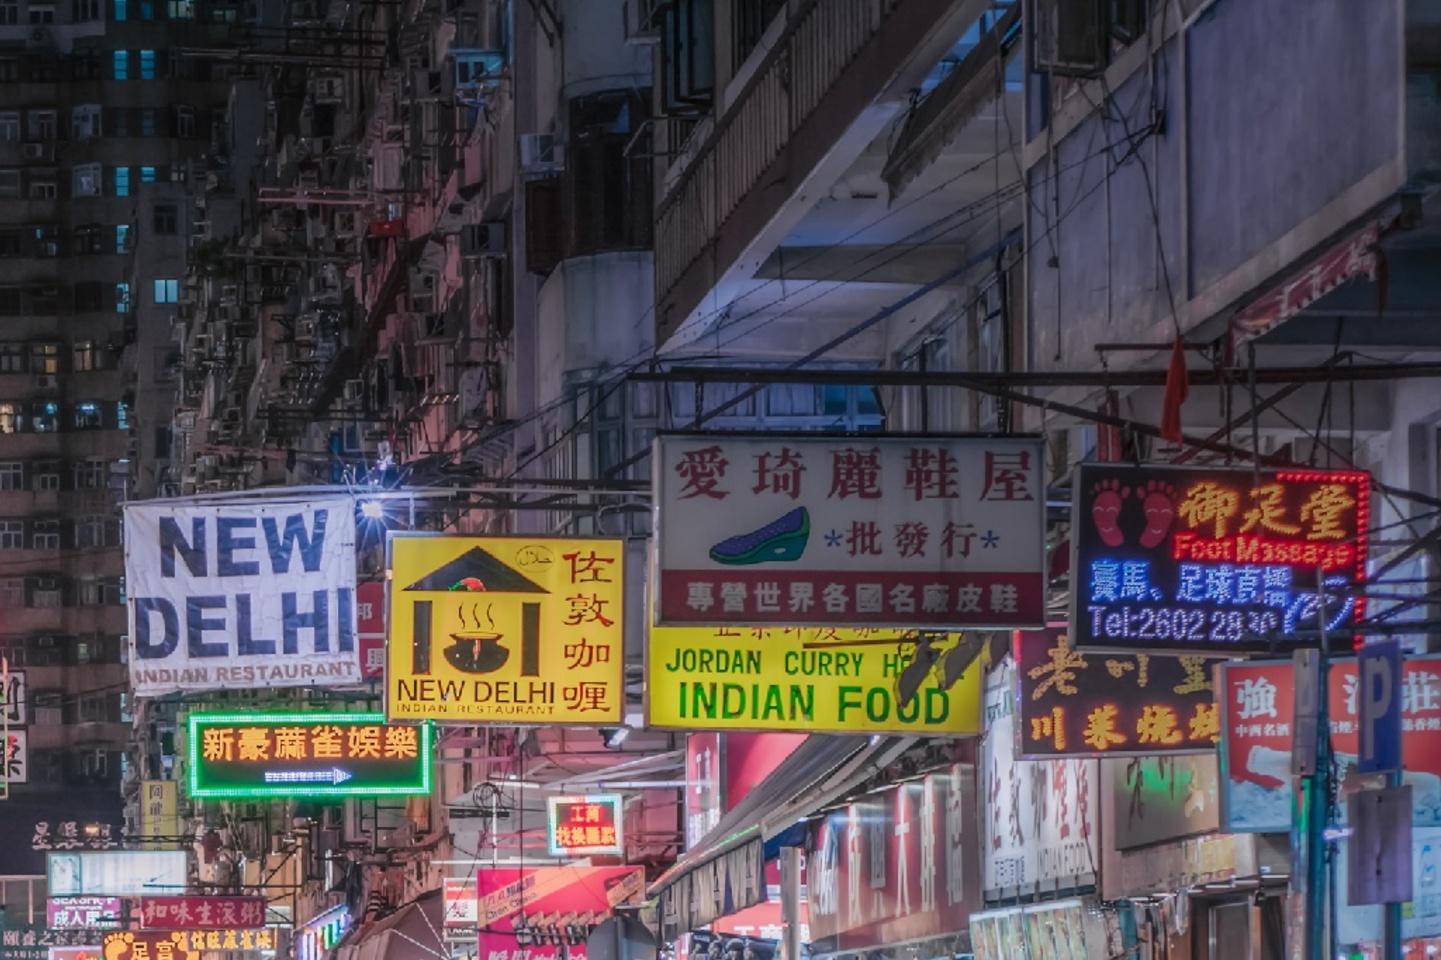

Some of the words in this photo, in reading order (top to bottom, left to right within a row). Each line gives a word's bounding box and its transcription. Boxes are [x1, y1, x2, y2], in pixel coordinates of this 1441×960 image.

[674, 445, 1034, 501] 愛琦麗鞋屋
[1178, 481, 1355, 540] 御足堂
[159, 509, 328, 577] NEW
[845, 520, 977, 559] 批發行
[1173, 533, 1231, 561] Foot
[1235, 535, 1354, 570] Massage
[687, 581, 1019, 614] 專營世界各國名廠皮鞋
[135, 586, 355, 659] DELHI
[561, 550, 615, 713] 佐敦咖喱
[1087, 605, 1206, 641] Tel:2602
[135, 666, 208, 683] INDIAN
[216, 662, 356, 682] RESTAURANT
[665, 648, 761, 674] JORDAN
[784, 650, 864, 677] CURRY
[397, 679, 466, 702] NEW
[473, 681, 555, 704] DELHI
[397, 703, 448, 713] INDIAN
[456, 704, 555, 716] RESTAURANT
[679, 682, 814, 721] INDIAN
[838, 686, 950, 725] FOOD
[1366, 655, 1393, 761] P
[144, 900, 263, 926] 和味生滾粥
